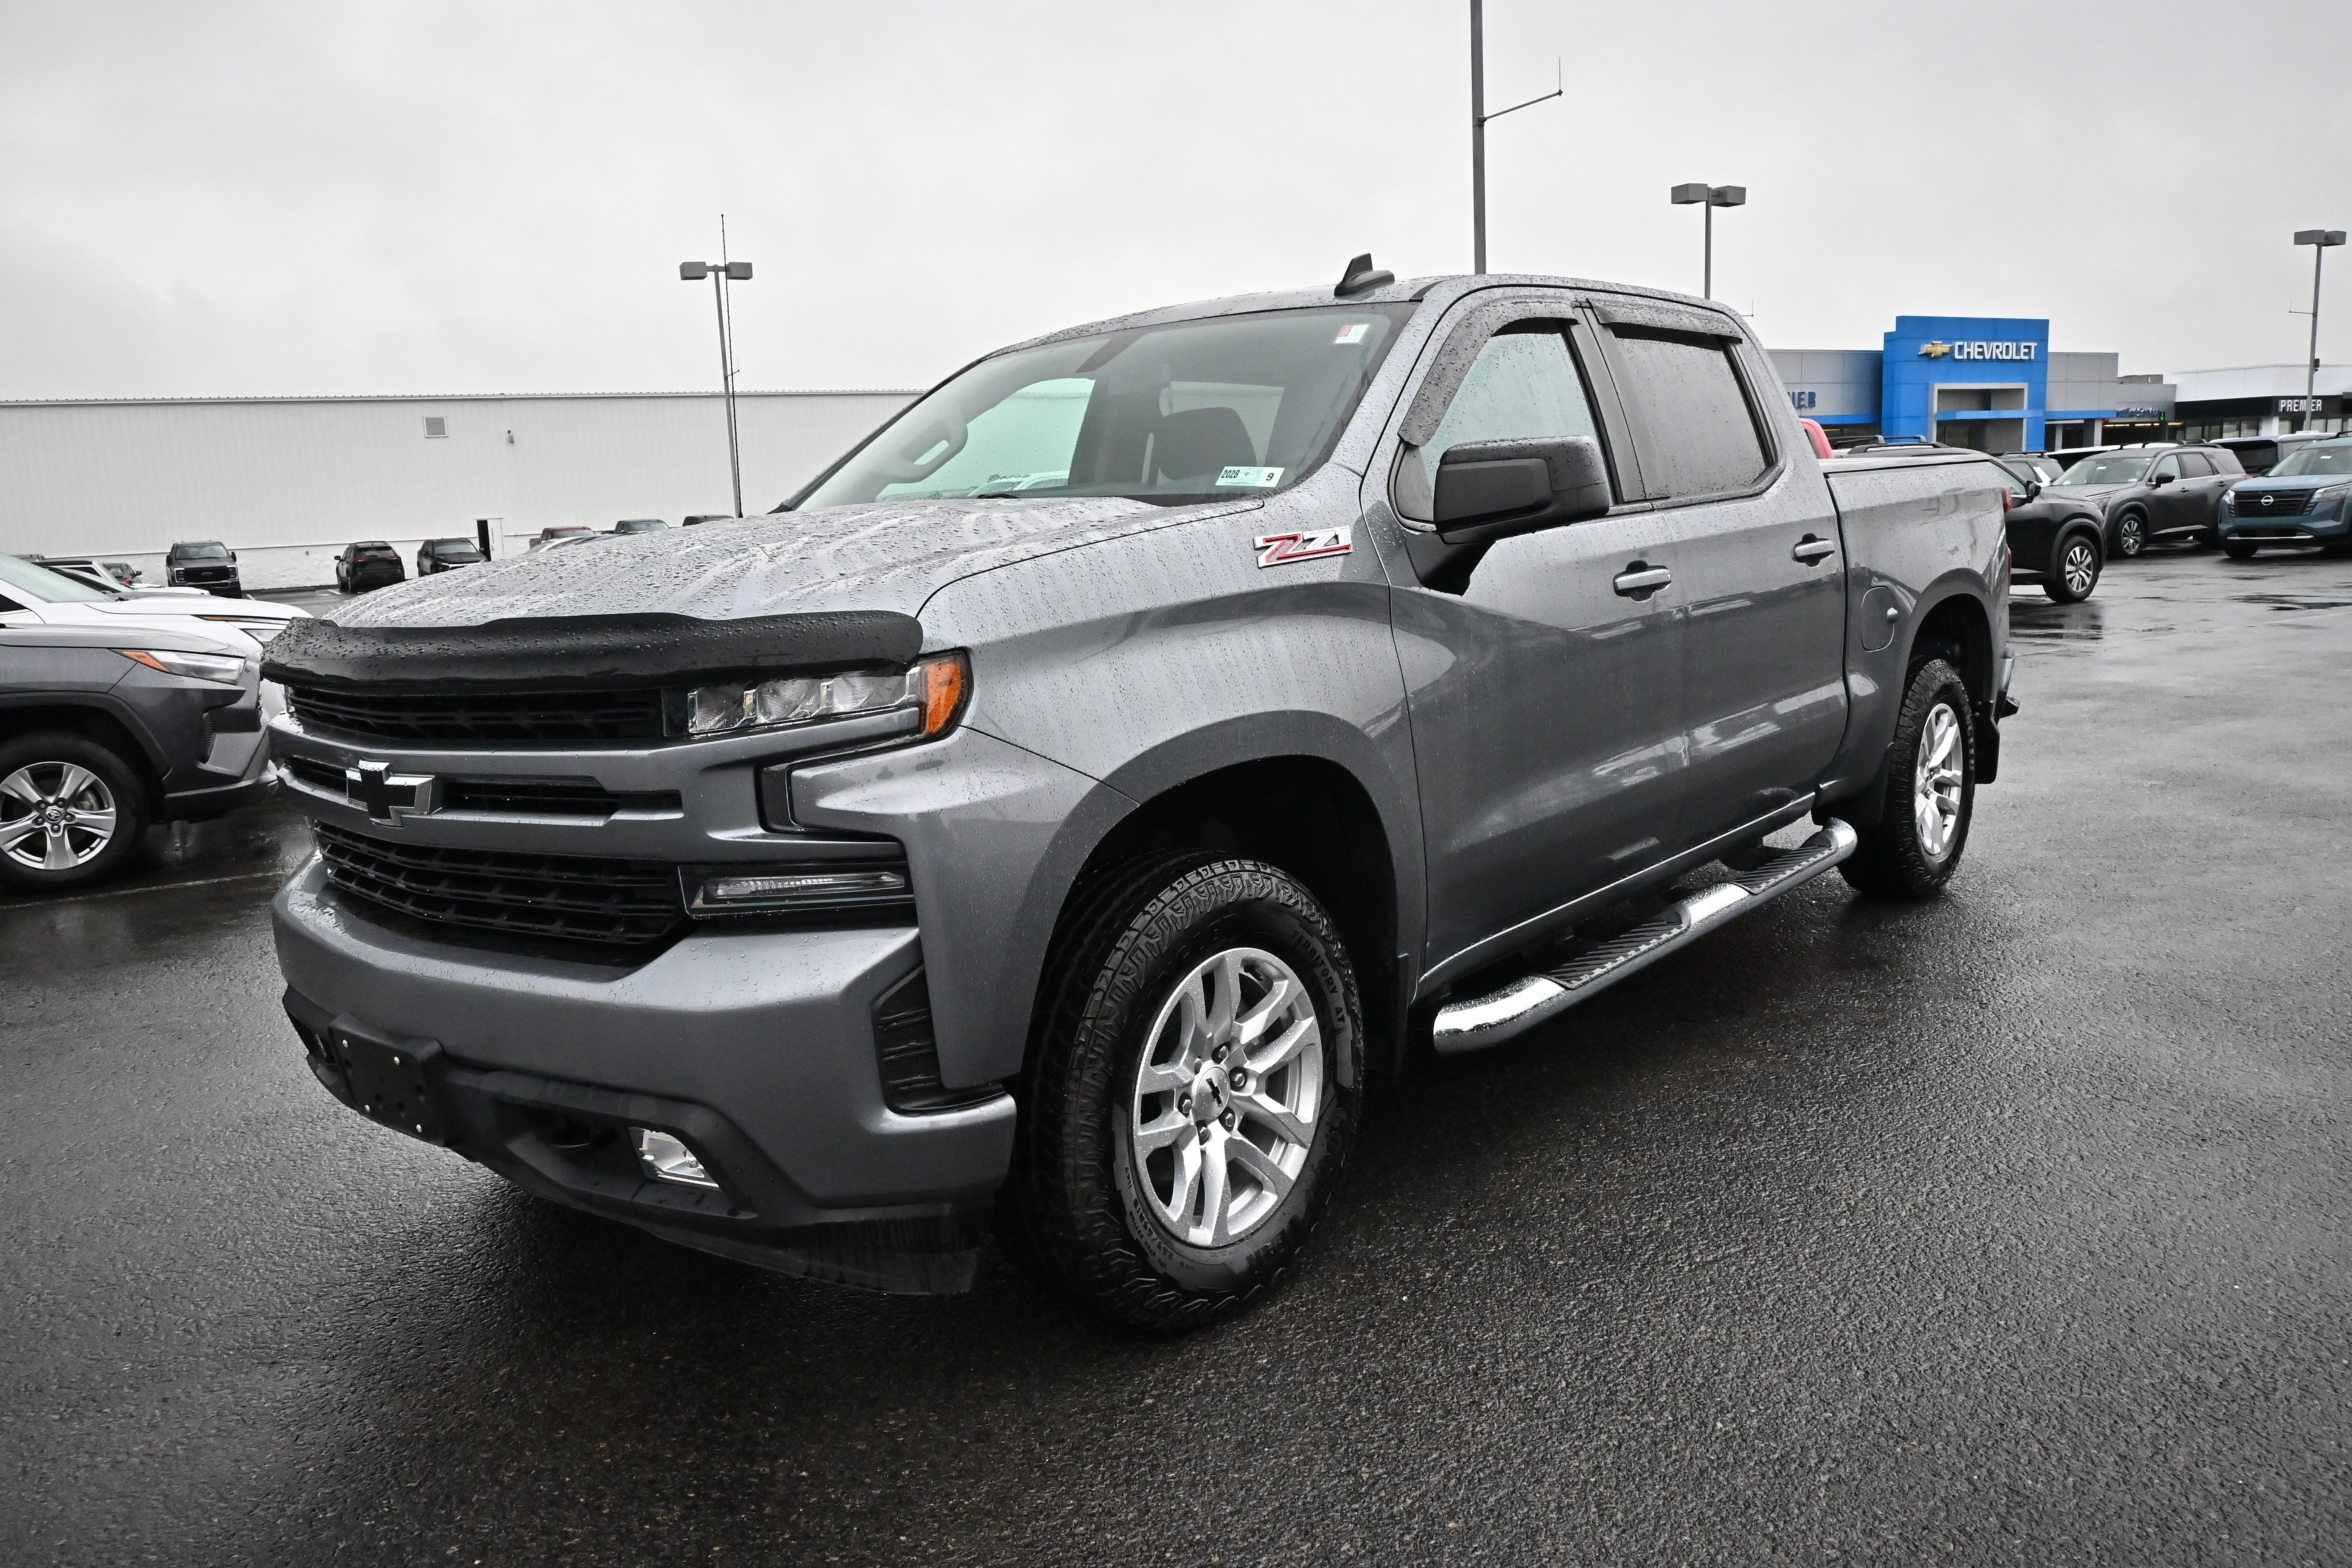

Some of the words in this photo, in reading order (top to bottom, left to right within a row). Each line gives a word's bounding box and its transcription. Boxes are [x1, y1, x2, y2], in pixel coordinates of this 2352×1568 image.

[1953, 341, 2037, 360] CHEVROLET
[1787, 392, 1816, 408] IER
[2278, 399, 2322, 412] PREMER
[1221, 469, 1240, 479] 2028
[1266, 472, 1274, 481] 9
[1253, 525, 1353, 569] Z71
[1334, 1005, 1345, 1024] AT
